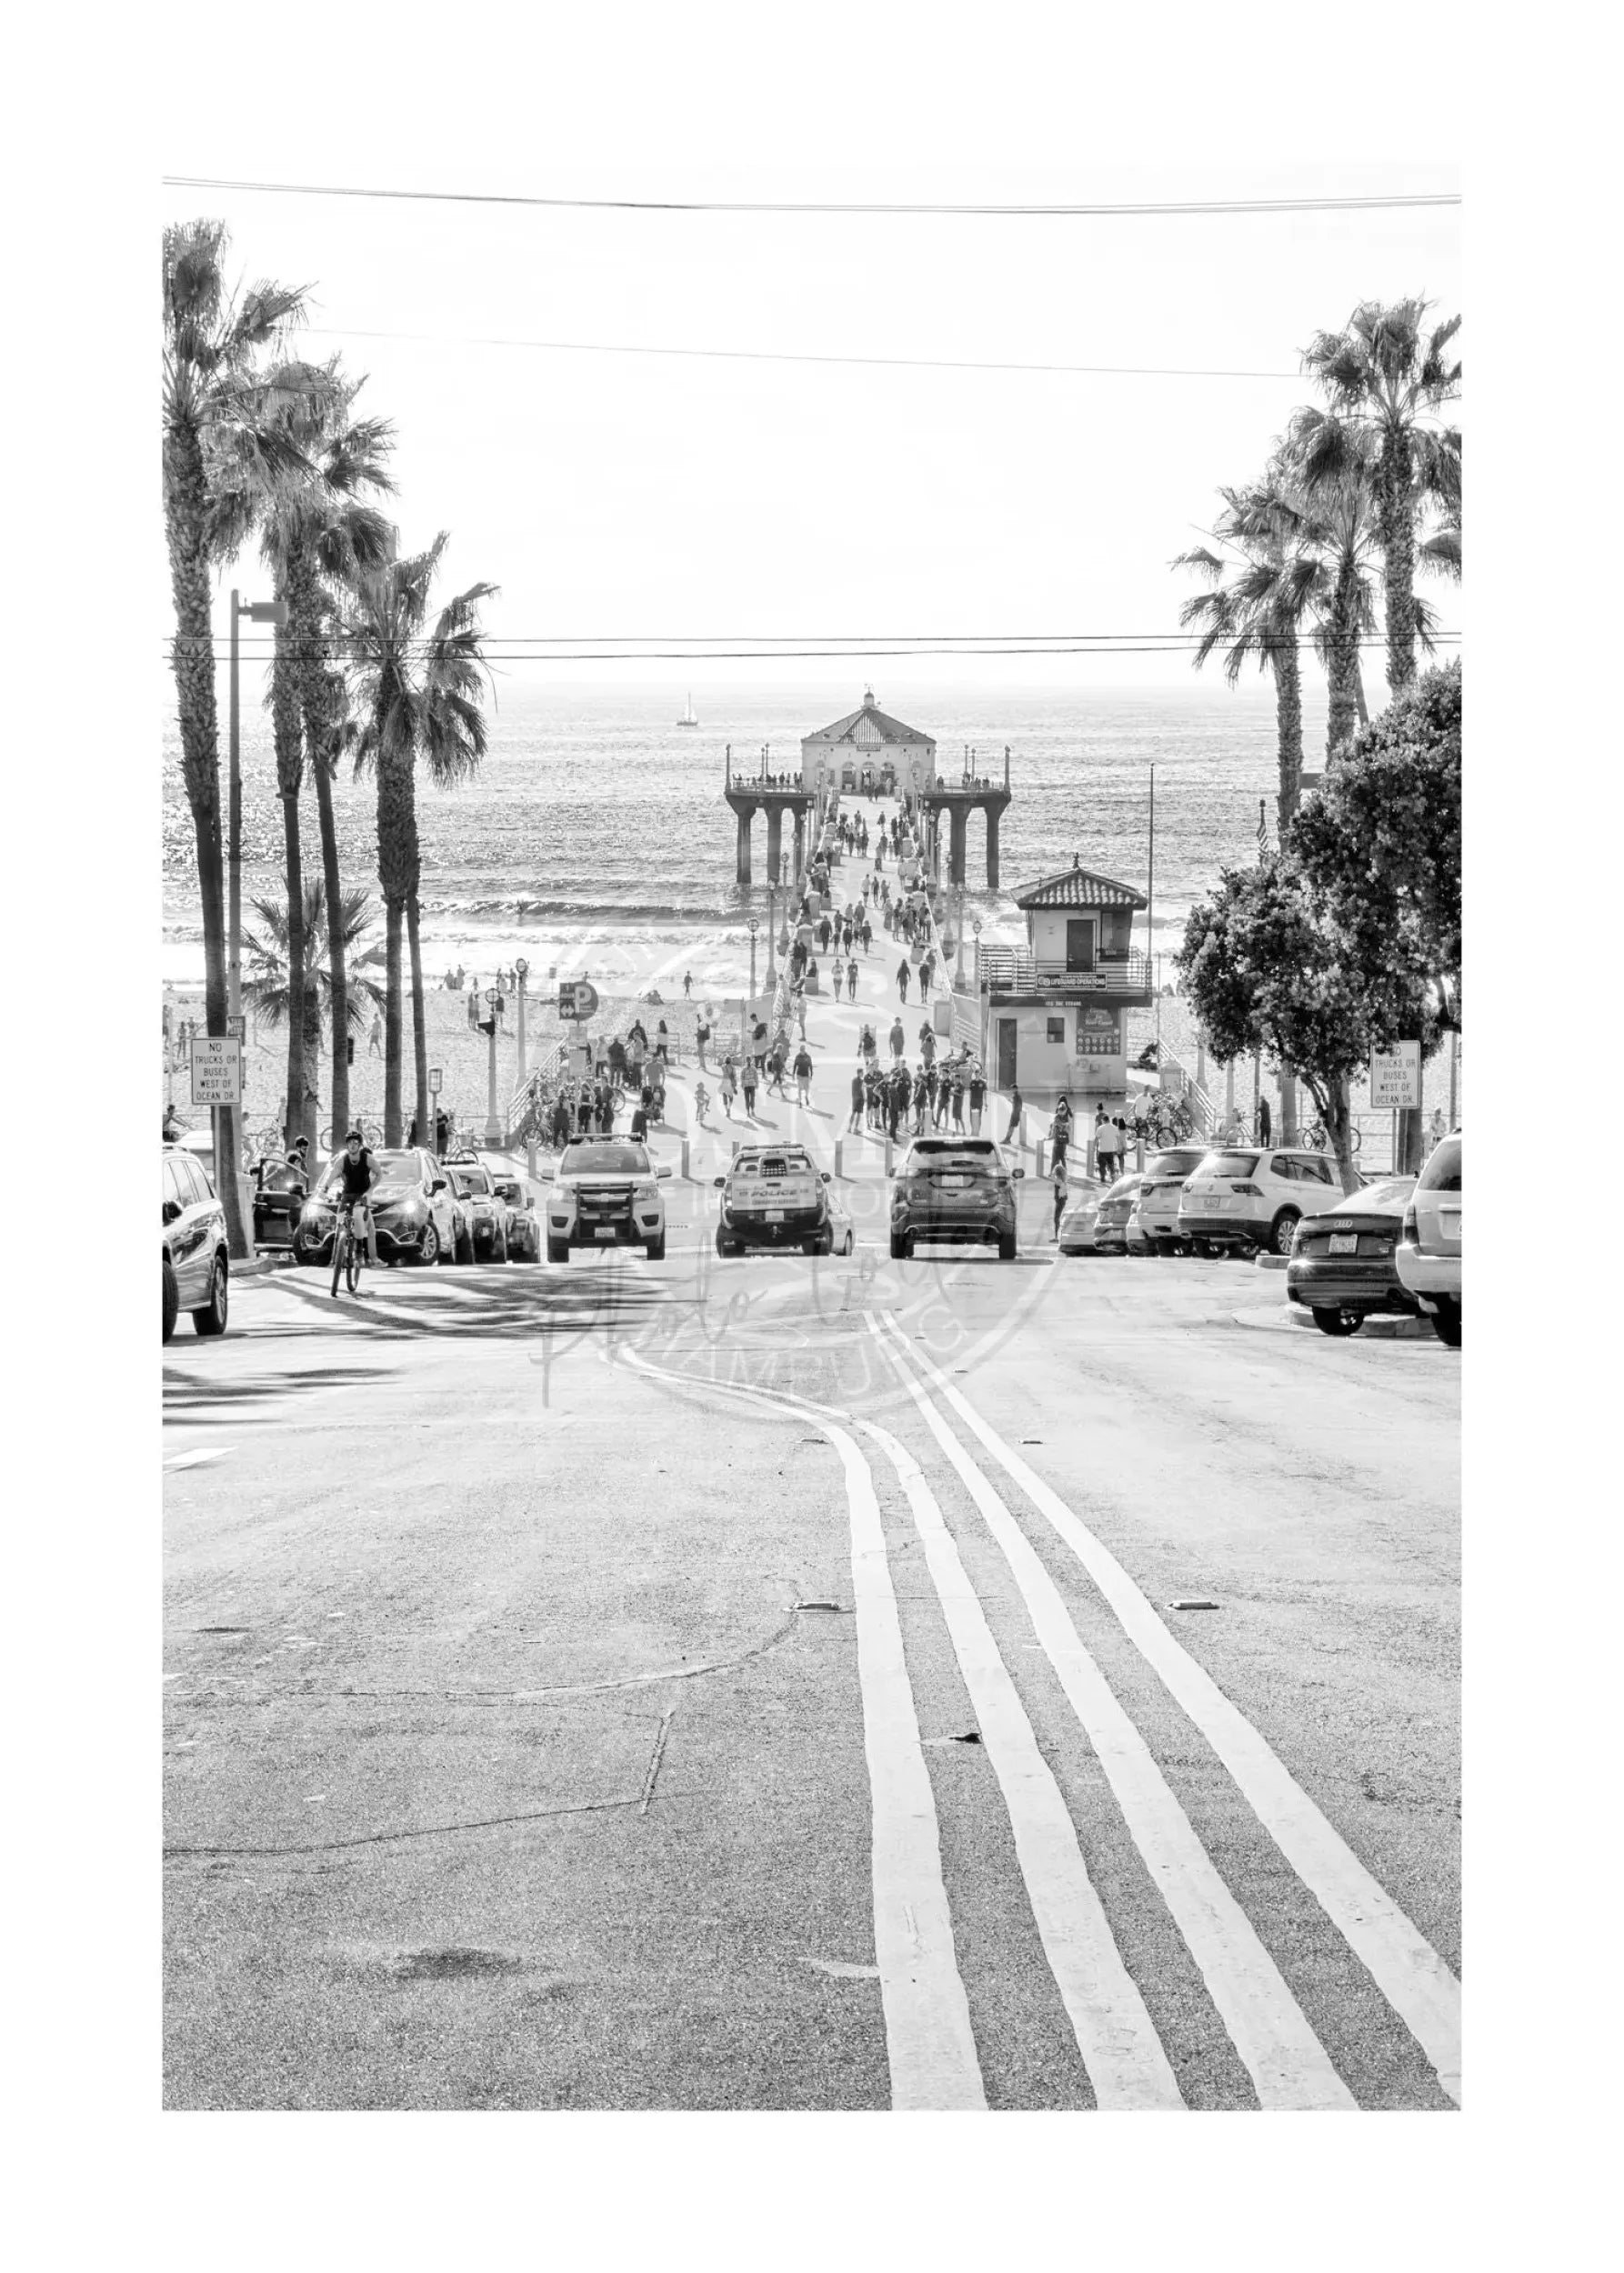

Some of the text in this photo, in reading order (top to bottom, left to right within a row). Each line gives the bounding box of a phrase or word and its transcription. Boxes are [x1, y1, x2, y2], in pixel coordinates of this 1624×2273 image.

[575, 986, 592, 1013] P
[209, 1043, 222, 1052] NO
[195, 1056, 237, 1064] TRUCKS OR
[1375, 1059, 1416, 1067] TRUCKS OR
[204, 1067, 228, 1076] BUSES
[1383, 1071, 1407, 1079] BUSES
[200, 1079, 232, 1088] WEST OF
[1379, 1083, 1410, 1091] WEST OF
[196, 1091, 220, 1100] OCEAN
[1375, 1095, 1399, 1104] OCEAN
[751, 1188, 797, 1197] POLICE
